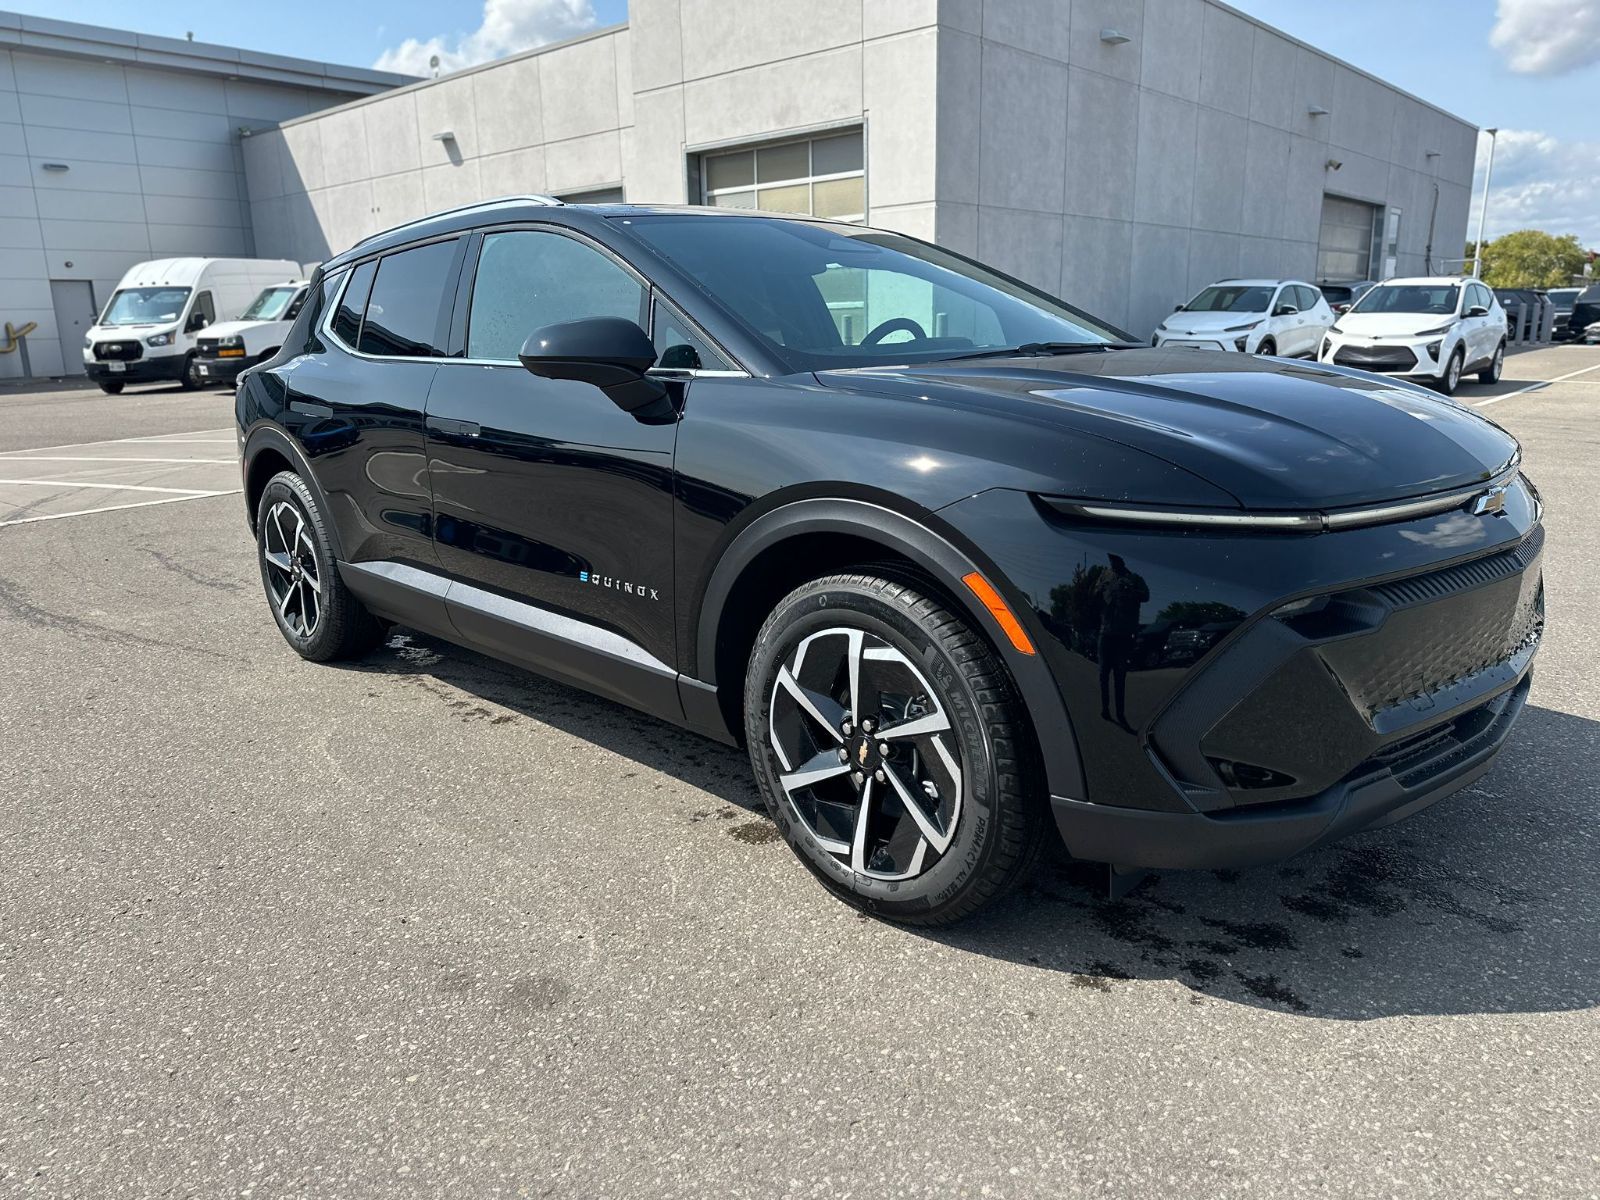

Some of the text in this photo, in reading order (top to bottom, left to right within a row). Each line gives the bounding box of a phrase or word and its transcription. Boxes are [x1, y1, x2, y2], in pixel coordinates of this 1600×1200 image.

[579, 570, 659, 601] EQUINOX
[950, 691, 988, 801] MICHELIN
[964, 816, 987, 872] PRIMACY
